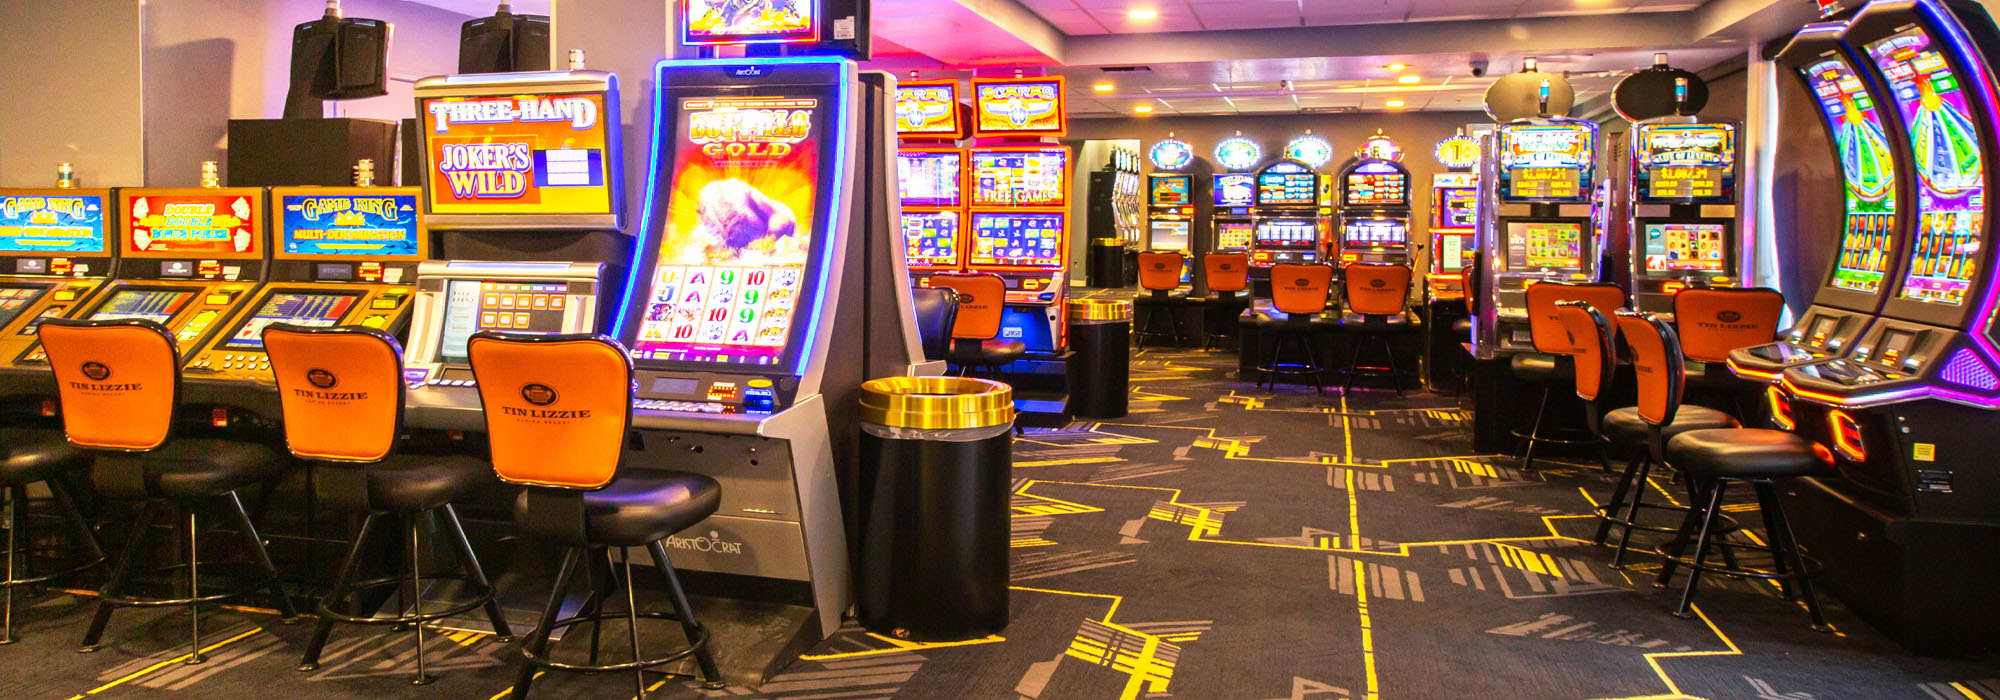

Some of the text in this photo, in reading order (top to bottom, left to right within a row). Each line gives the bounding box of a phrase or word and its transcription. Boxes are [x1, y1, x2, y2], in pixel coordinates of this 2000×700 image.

[429, 97, 597, 133] THREE-HAND
[689, 109, 811, 144] BUFFALO
[703, 142, 792, 157] GOLD
[440, 143, 531, 173] JOKER'S
[448, 170, 527, 199] WILD
[984, 190, 1011, 202] FREE
[47, 197, 86, 220] KING
[164, 204, 215, 216] DOUBLE
[302, 198, 398, 221] GAME KING
[165, 217, 213, 227] DOUBLE
[152, 229, 229, 240] BONUS POKER
[293, 228, 406, 240] MULTI-DENOMINATION
[720, 270, 735, 285] 9
[747, 270, 765, 285] 10
[744, 289, 759, 304] 9
[708, 307, 754, 323] 10 9
[674, 324, 693, 339] 10
[69, 381, 143, 391] TIN LIZZIE
[293, 388, 368, 400] TIN LIZZIE
[502, 406, 591, 419] TIN LIZZIE
[666, 534, 742, 554] ARISTOCRAT
